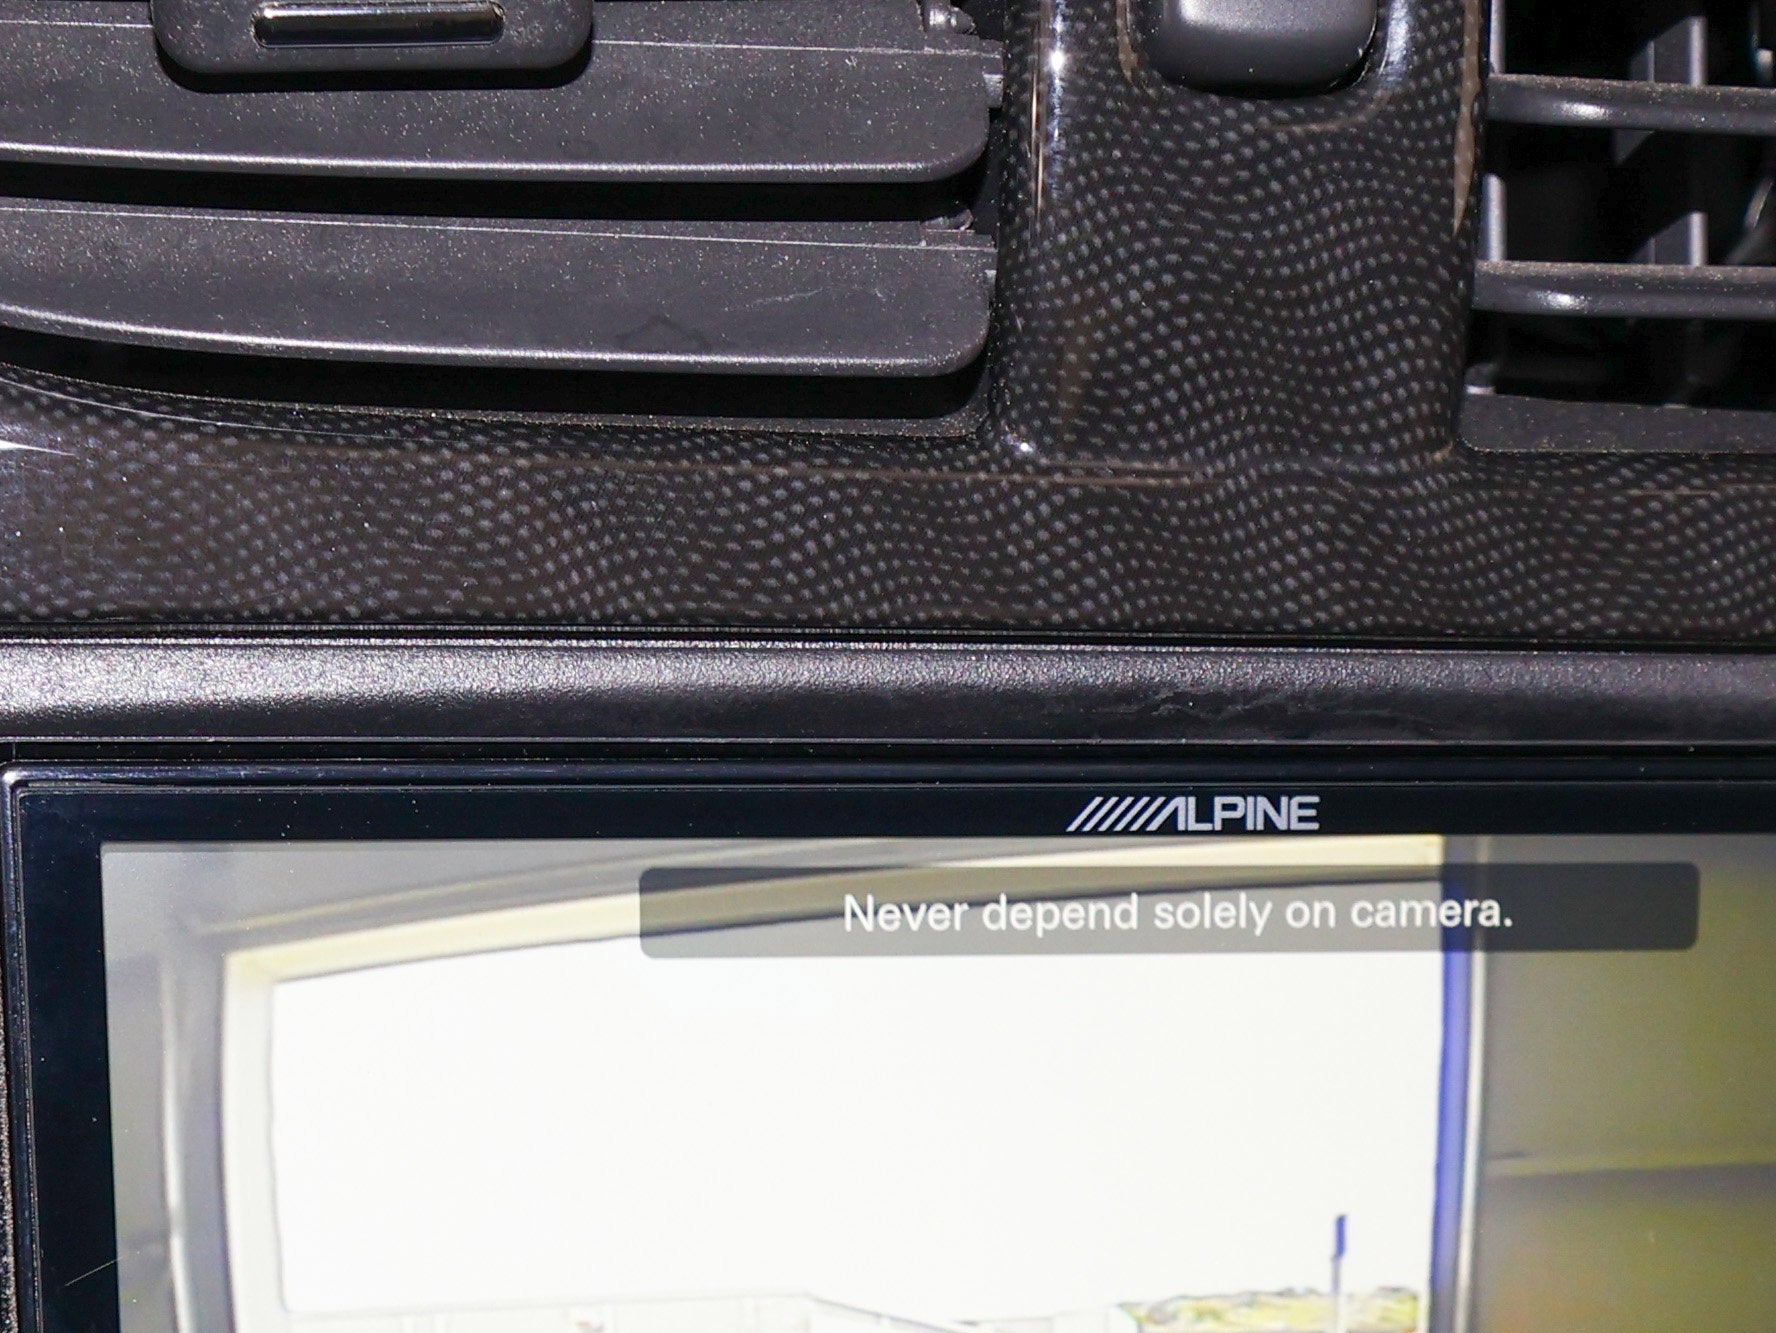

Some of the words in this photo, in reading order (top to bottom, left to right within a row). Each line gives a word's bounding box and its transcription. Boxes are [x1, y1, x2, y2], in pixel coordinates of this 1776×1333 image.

[1143, 795, 1322, 832] ALPINE
[844, 893, 970, 932] Never
[982, 892, 1139, 938] depend
[1154, 892, 1272, 937] solely
[1285, 899, 1337, 929] on
[1350, 897, 1514, 929] camera.
